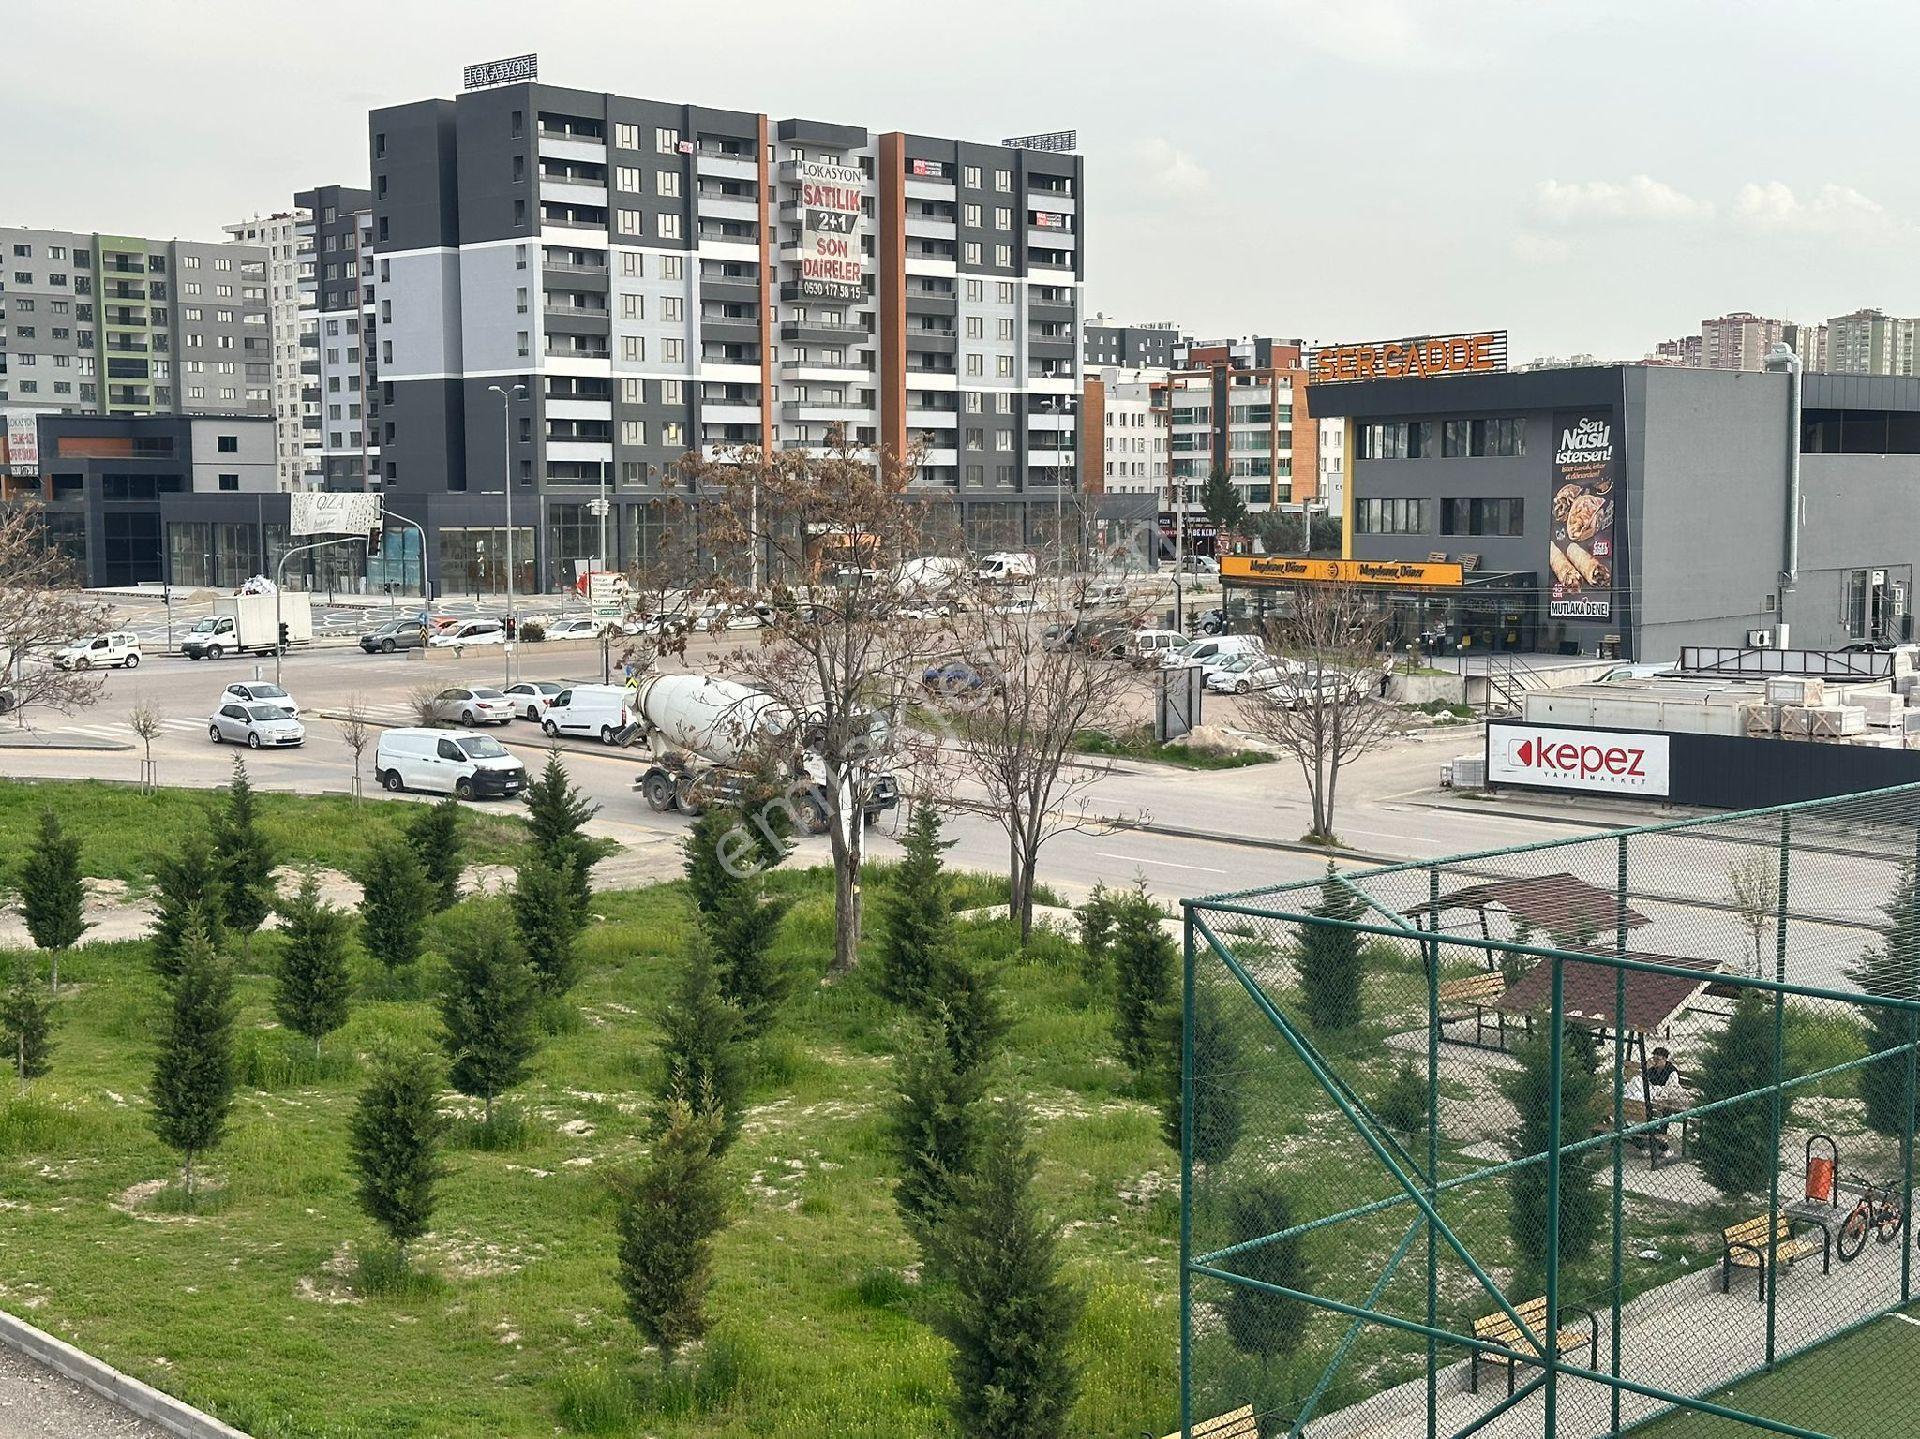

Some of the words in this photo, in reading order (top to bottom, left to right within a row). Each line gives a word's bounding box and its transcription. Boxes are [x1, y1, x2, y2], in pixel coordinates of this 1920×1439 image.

[469, 60, 530, 83] LOKASYON
[802, 164, 861, 181] LOKASYON
[803, 184, 861, 211] SATILIK
[818, 213, 846, 231] 2+1
[816, 238, 848, 258] SON
[804, 282, 822, 295] 0530
[825, 284, 838, 296] 177
[840, 286, 849, 298] 58
[851, 287, 860, 299] 15
[1317, 347, 1376, 380] SER
[1383, 335, 1494, 378] CADDE
[1578, 418, 1603, 433] Sen
[1561, 425, 1610, 450] Nasıl
[1555, 445, 1612, 464] istersen!
[1552, 602, 1585, 615] MUTLAKA
[1586, 602, 1608, 615] DENE!
[1537, 737, 1645, 779] kepez
[1544, 771, 1575, 780] YAPI
[1590, 775, 1646, 785] MARKET
